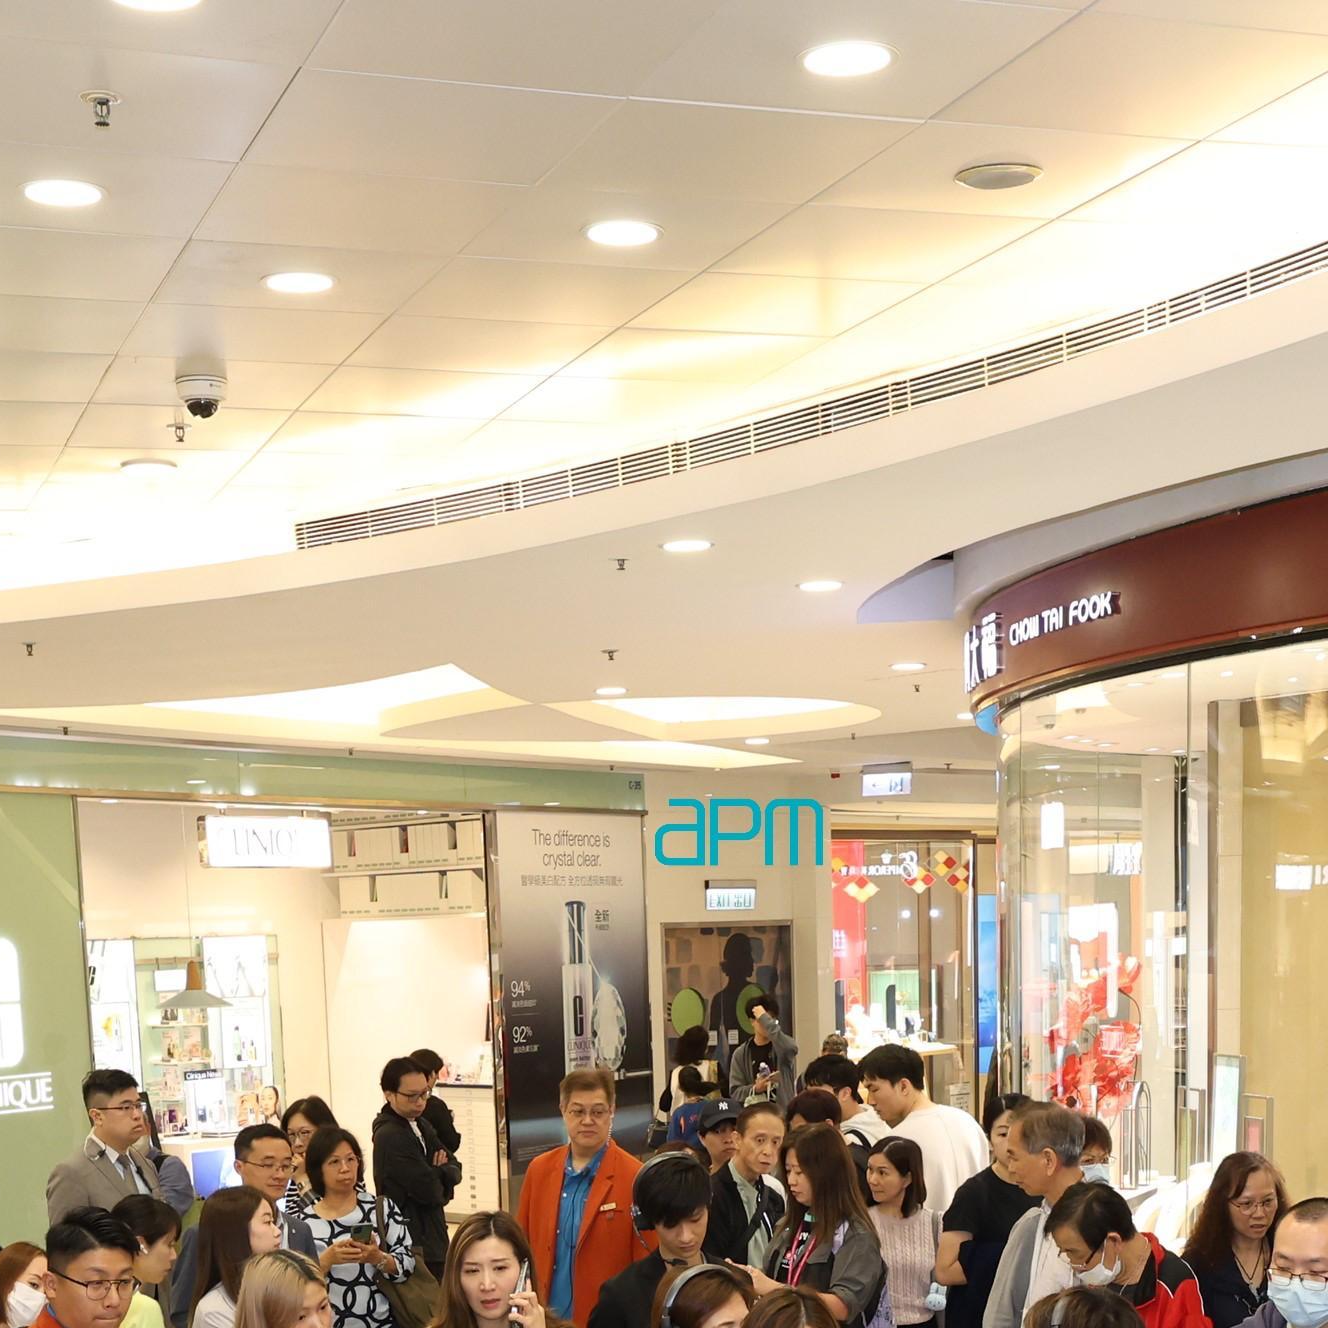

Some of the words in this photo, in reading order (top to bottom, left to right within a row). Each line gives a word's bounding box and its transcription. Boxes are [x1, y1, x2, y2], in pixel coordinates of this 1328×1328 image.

[1009, 615, 1039, 646] CHOW
[1041, 605, 1063, 634] TAI
[1069, 591, 1112, 626] FOOK
[963, 612, 997, 694] 大福
[532, 829, 551, 846] The
[554, 830, 600, 848] difference
[603, 832, 611, 848] is
[542, 851, 575, 870] crystal
[577, 852, 602, 868] clear.
[709, 895, 731, 908] EXIT
[734, 894, 752, 908] 出口
[511, 980, 531, 998] 94%
[512, 1026, 533, 1044] 92%
